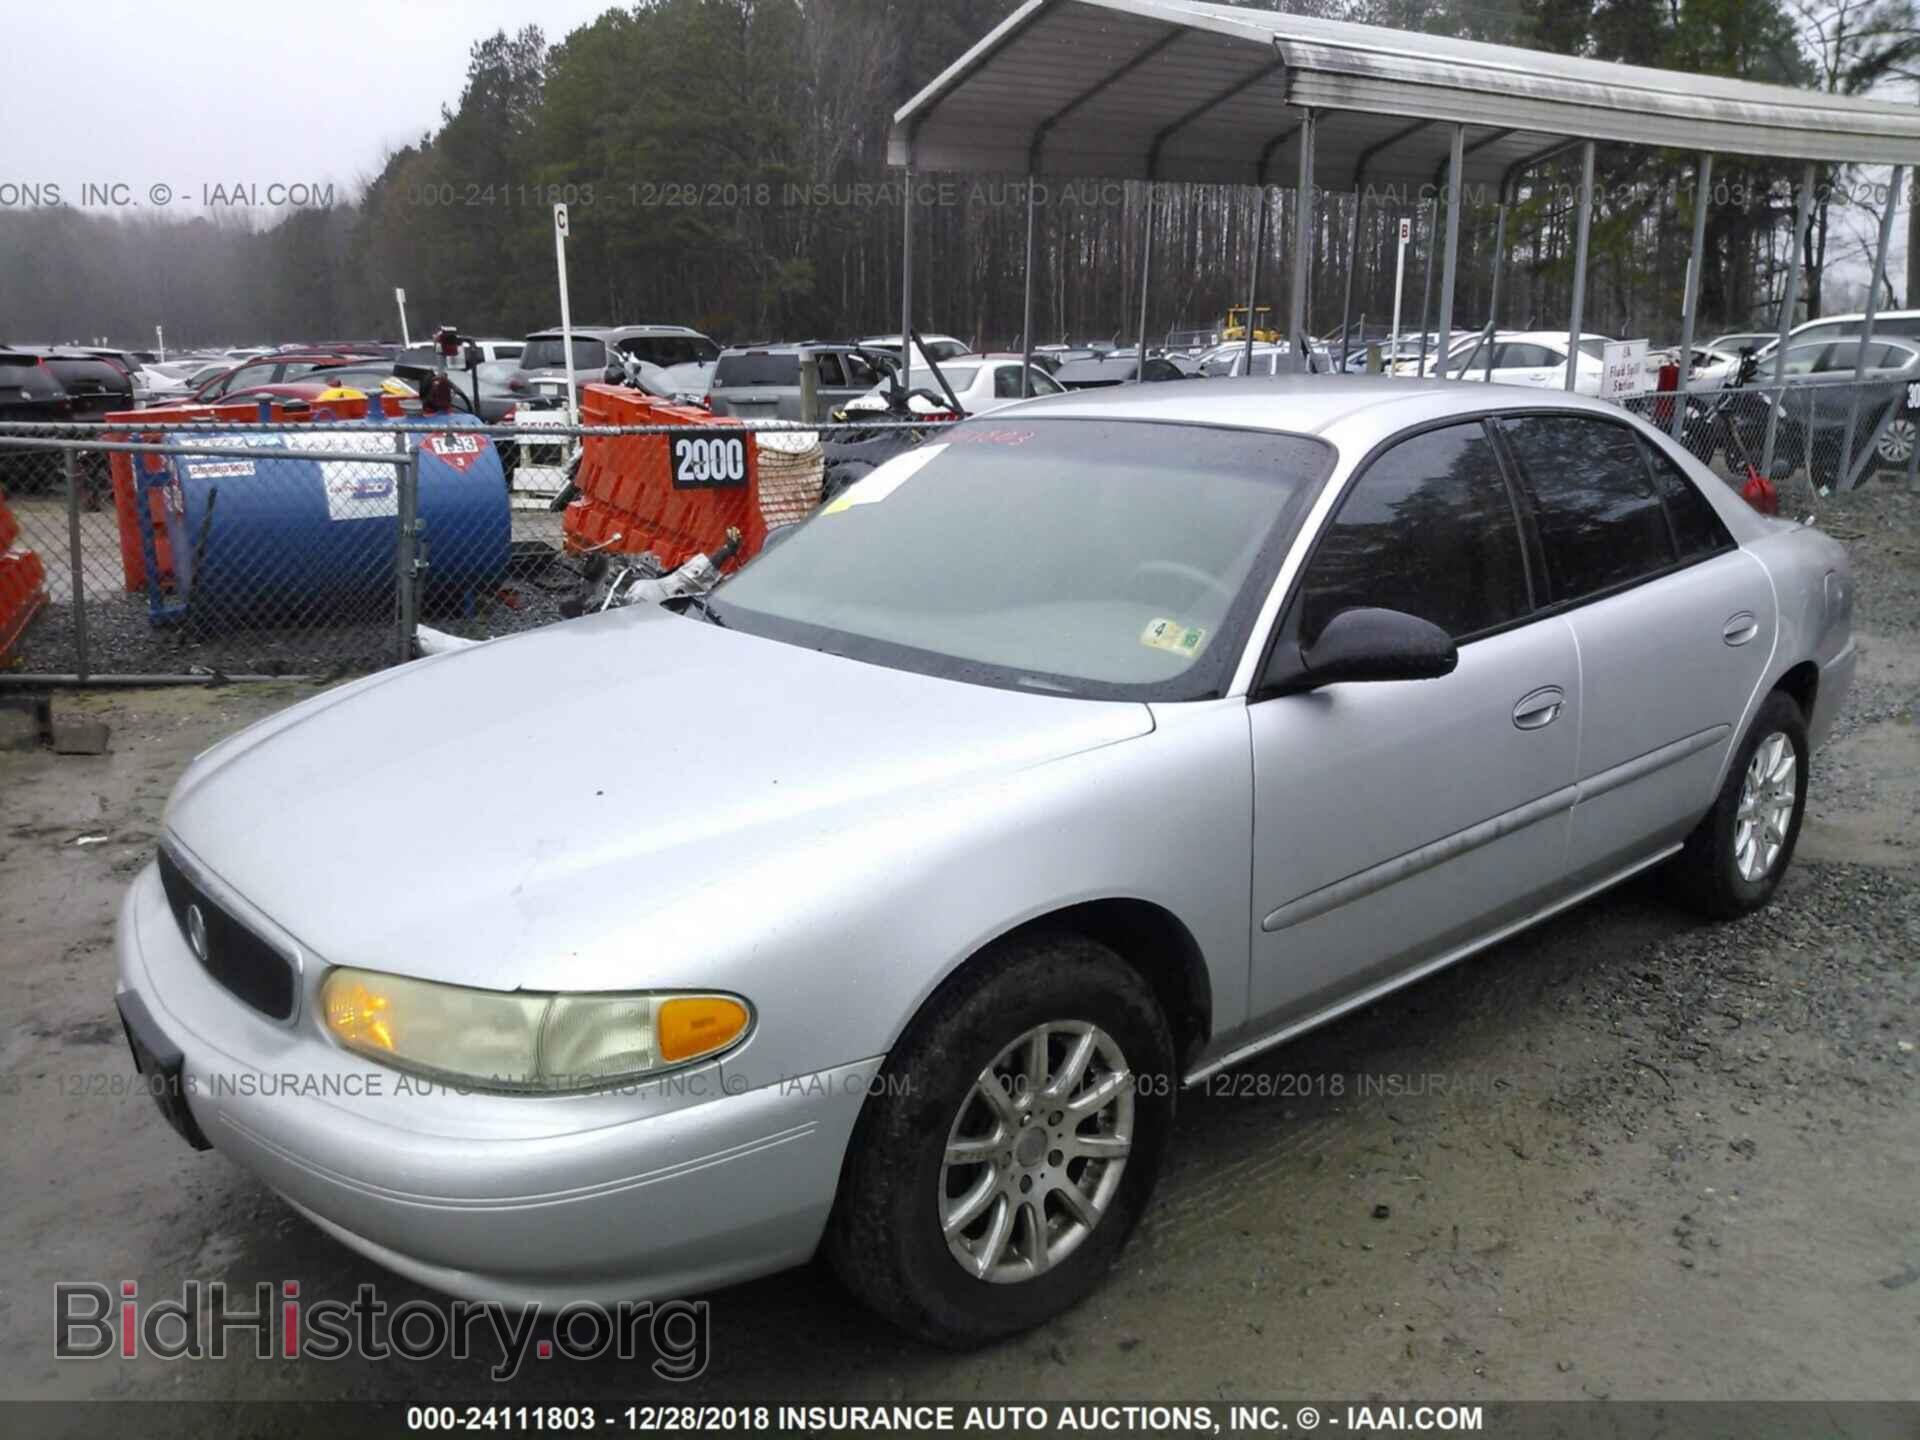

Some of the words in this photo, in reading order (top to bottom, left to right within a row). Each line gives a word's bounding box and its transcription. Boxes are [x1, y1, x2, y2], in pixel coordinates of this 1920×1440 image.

[557, 210, 566, 229] C
[1402, 223, 1409, 238] B
[675, 438, 744, 481] 2000
